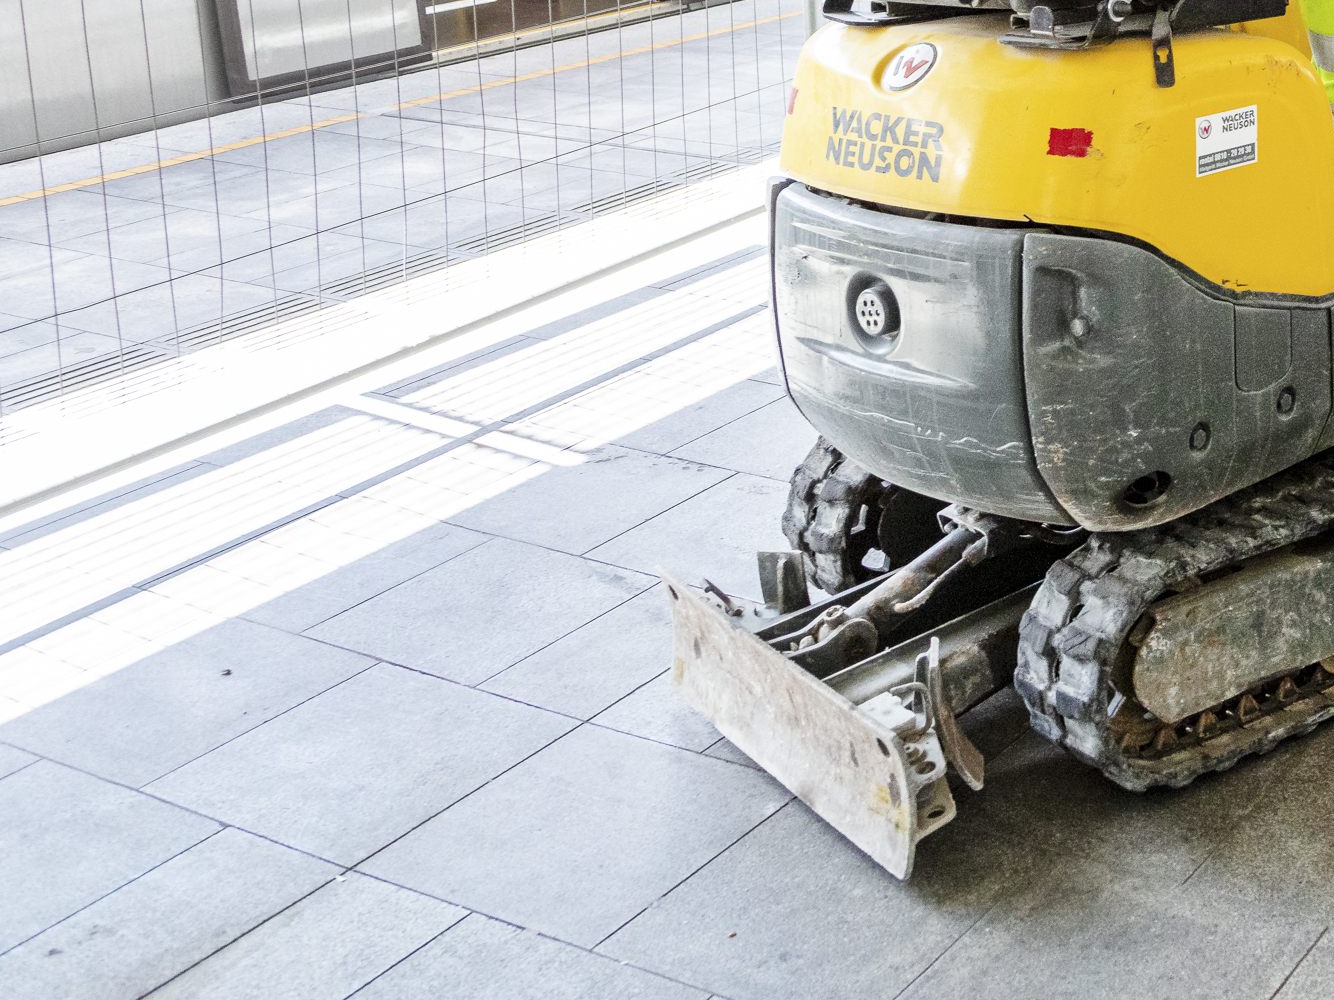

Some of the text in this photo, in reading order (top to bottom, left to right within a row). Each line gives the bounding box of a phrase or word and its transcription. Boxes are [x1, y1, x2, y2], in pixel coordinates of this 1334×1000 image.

[832, 106, 945, 152] WACKER
[1222, 110, 1255, 124] WACKER
[1222, 118, 1255, 133] NEUSON
[825, 136, 943, 183] NEUSON
